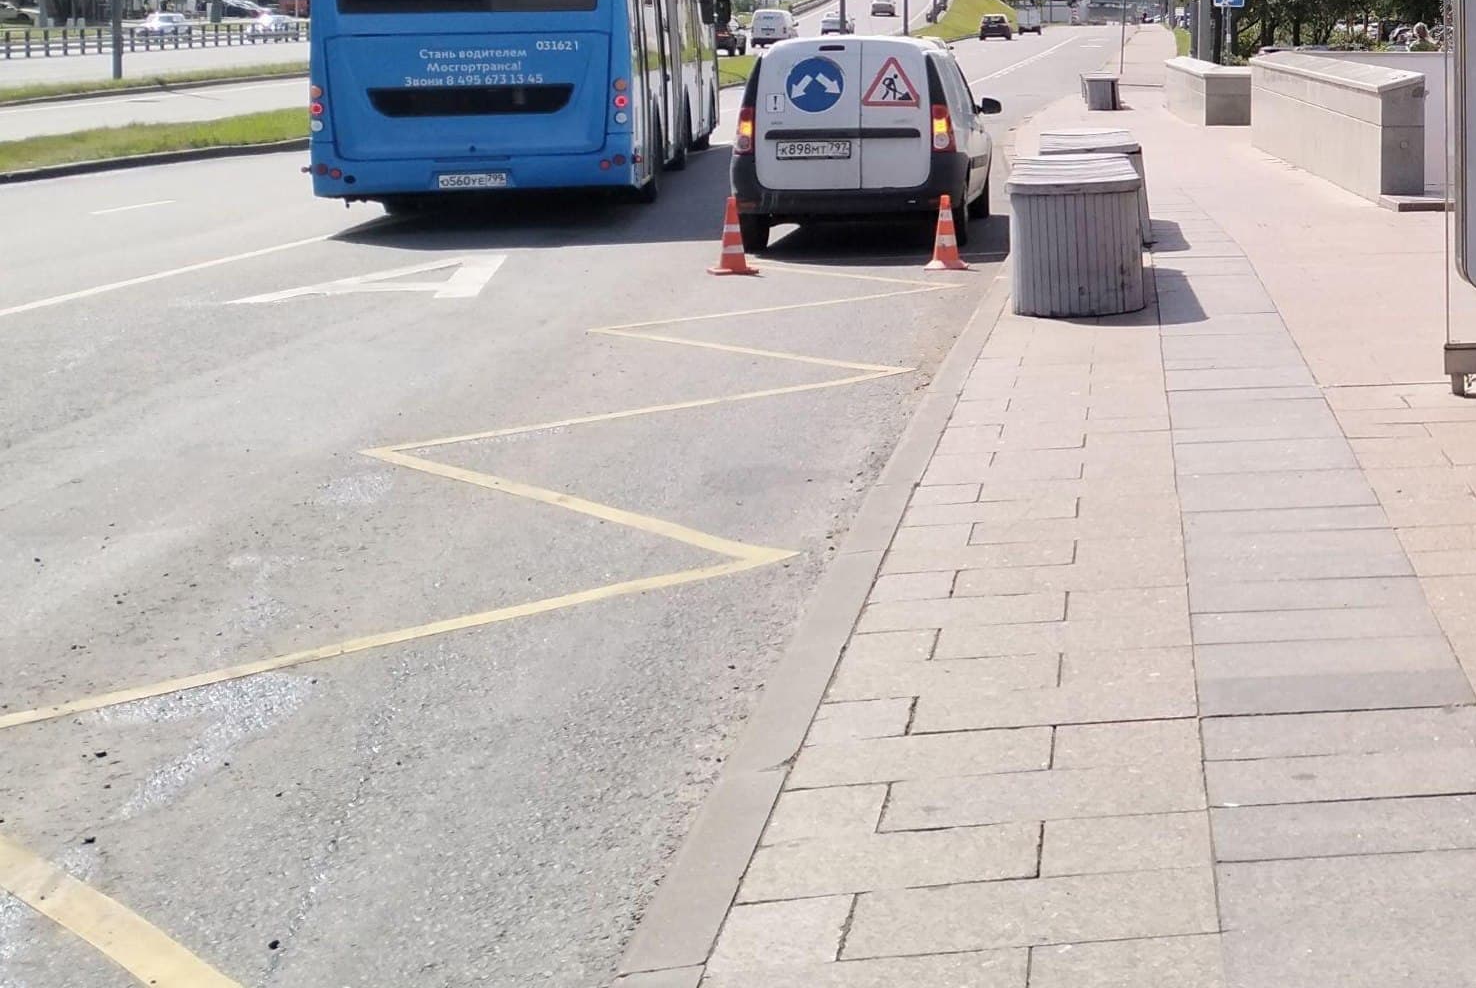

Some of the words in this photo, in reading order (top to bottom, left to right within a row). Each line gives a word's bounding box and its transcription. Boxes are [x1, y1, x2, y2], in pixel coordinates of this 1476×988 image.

[419, 49, 456, 60] Стань
[458, 48, 528, 60] водителем
[426, 61, 522, 73] Мосгортранса!
[404, 77, 443, 87] Звони
[446, 76, 454, 86] 8
[457, 75, 482, 85] 495
[485, 75, 507, 85] 673
[510, 74, 524, 84] 13
[527, 74, 544, 84] 45
[780, 144, 827, 156] К898МТ
[829, 142, 848, 151] 797
